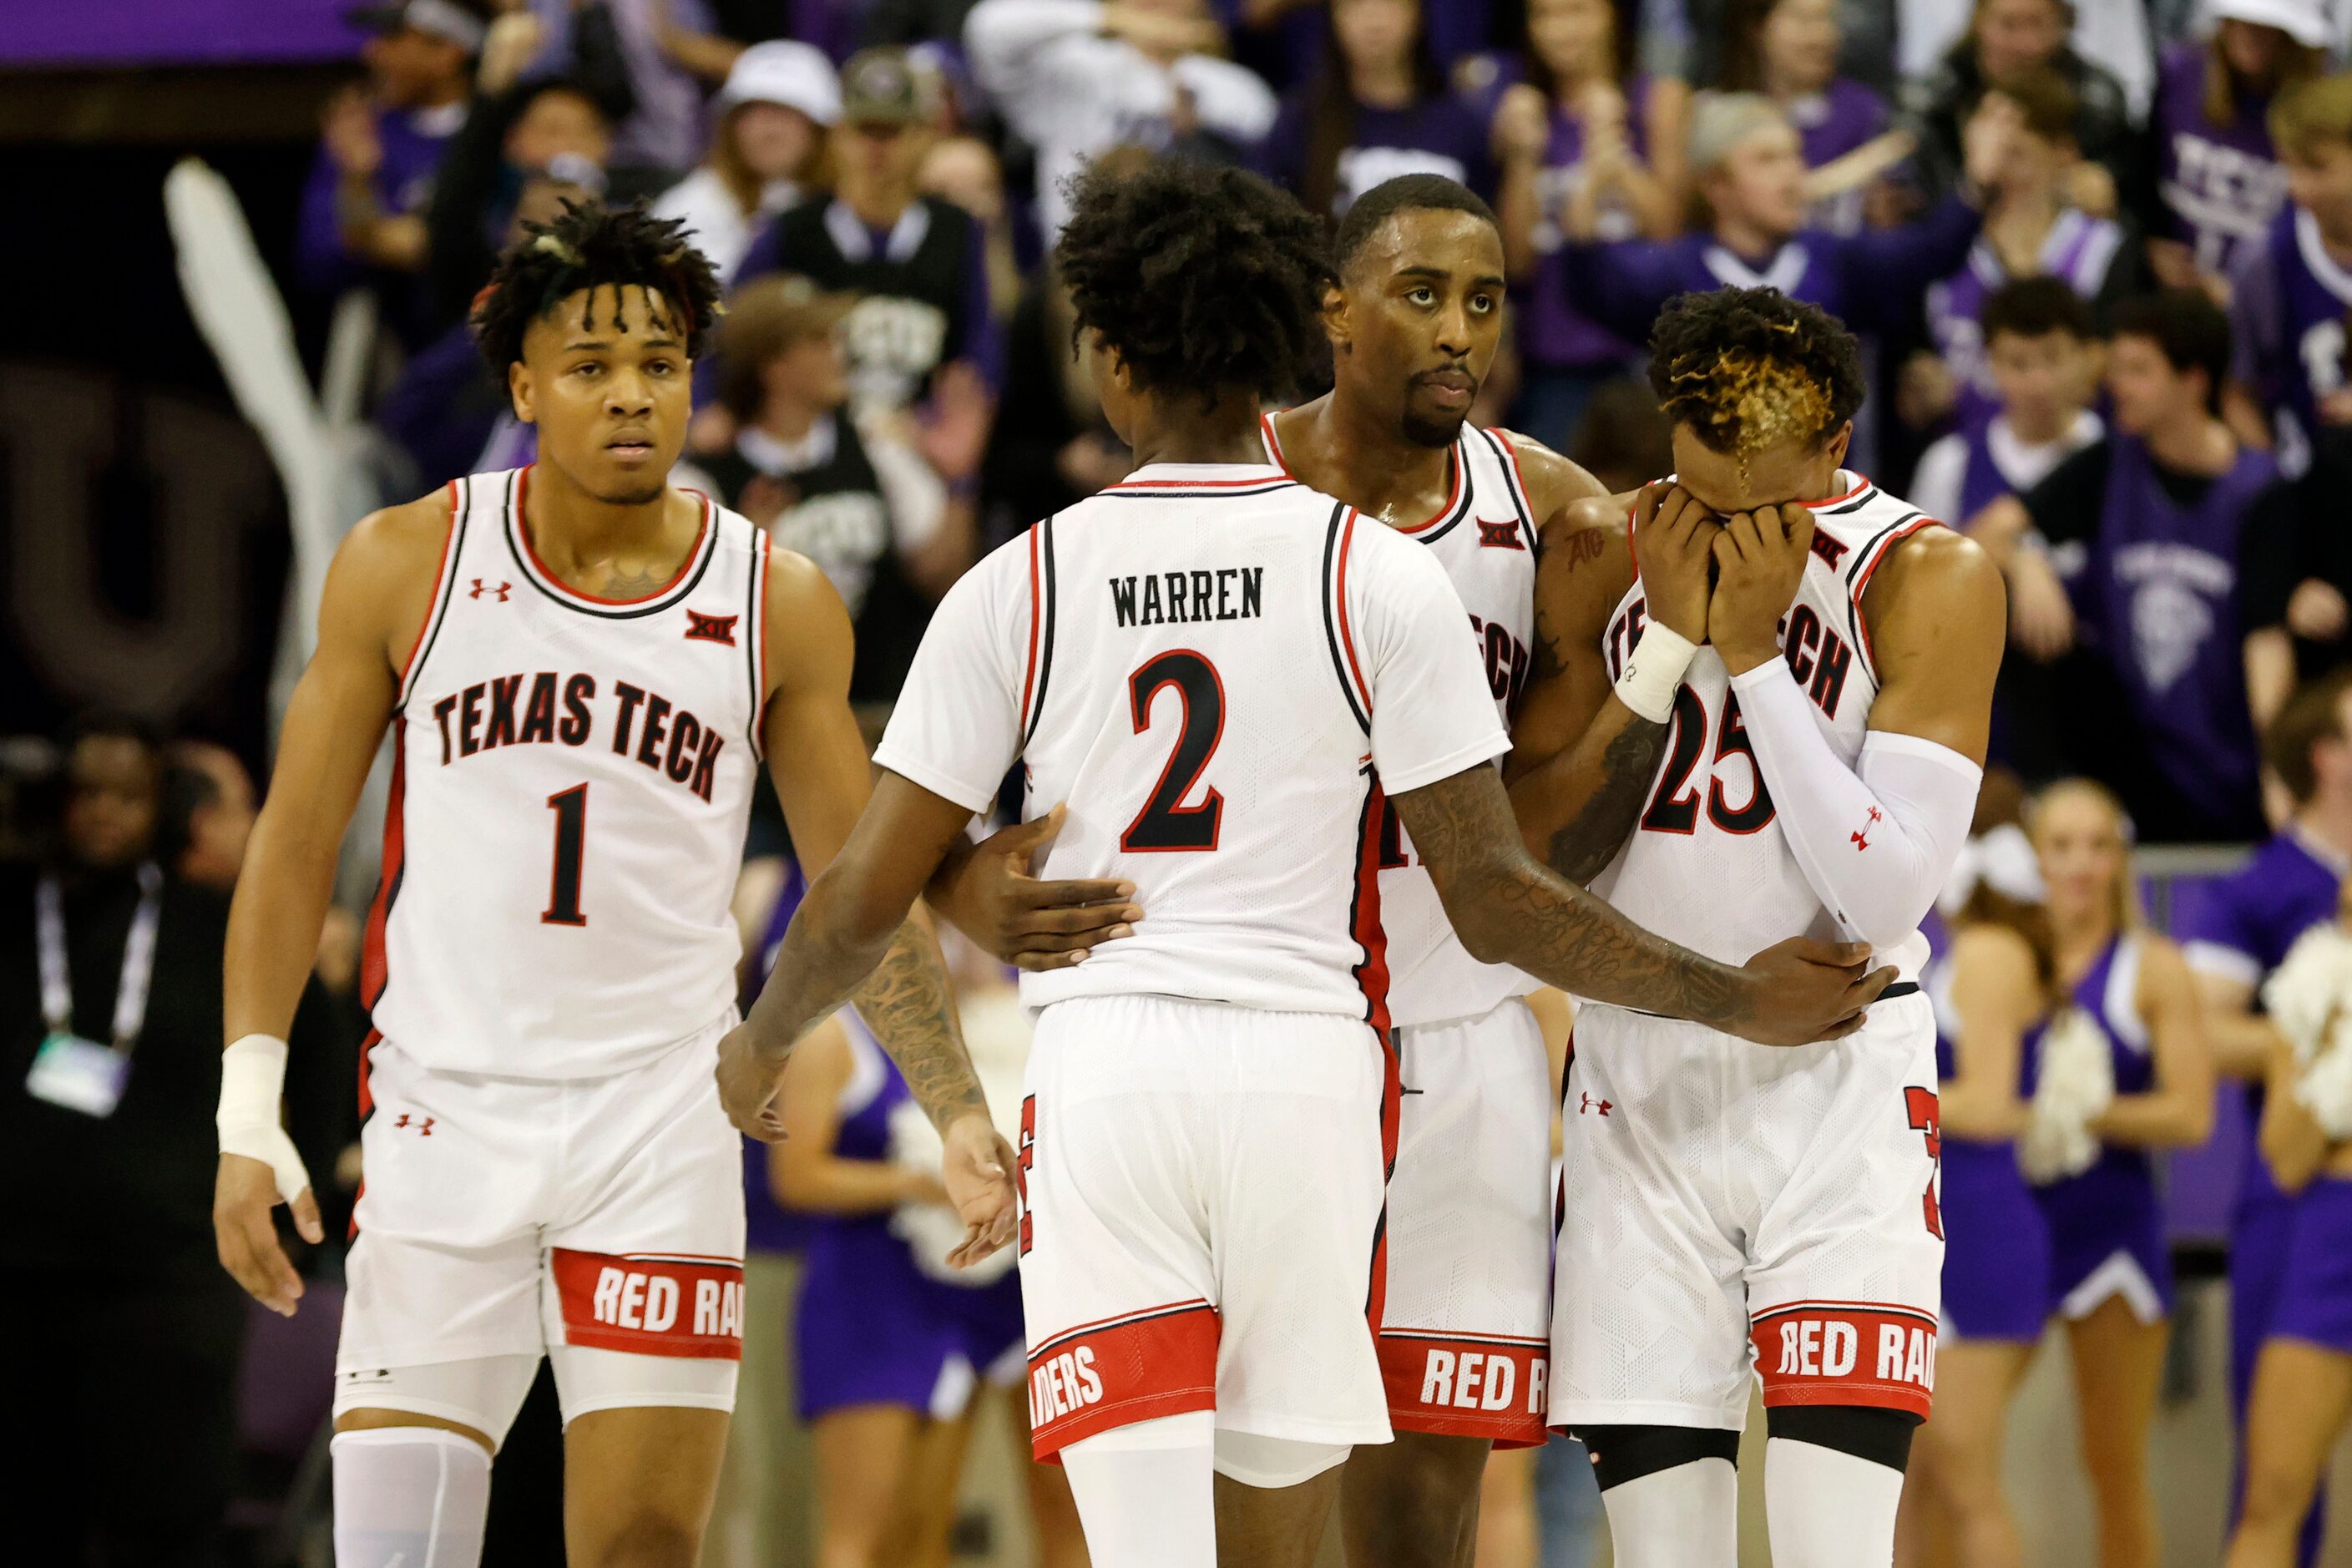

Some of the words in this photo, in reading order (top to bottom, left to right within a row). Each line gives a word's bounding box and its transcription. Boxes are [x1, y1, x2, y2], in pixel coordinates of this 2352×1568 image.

[1110, 567, 1263, 627] WARREN
[433, 672, 595, 767] TEXAS
[613, 680, 725, 805] TECH
[1120, 648, 1226, 853] 2
[1641, 683, 1777, 835] 25
[540, 782, 589, 927] 1
[594, 1267, 680, 1333] RED
[1028, 1346, 1103, 1430] IDERS
[1420, 1349, 1515, 1411] RED
[1776, 1320, 1858, 1377] RED
